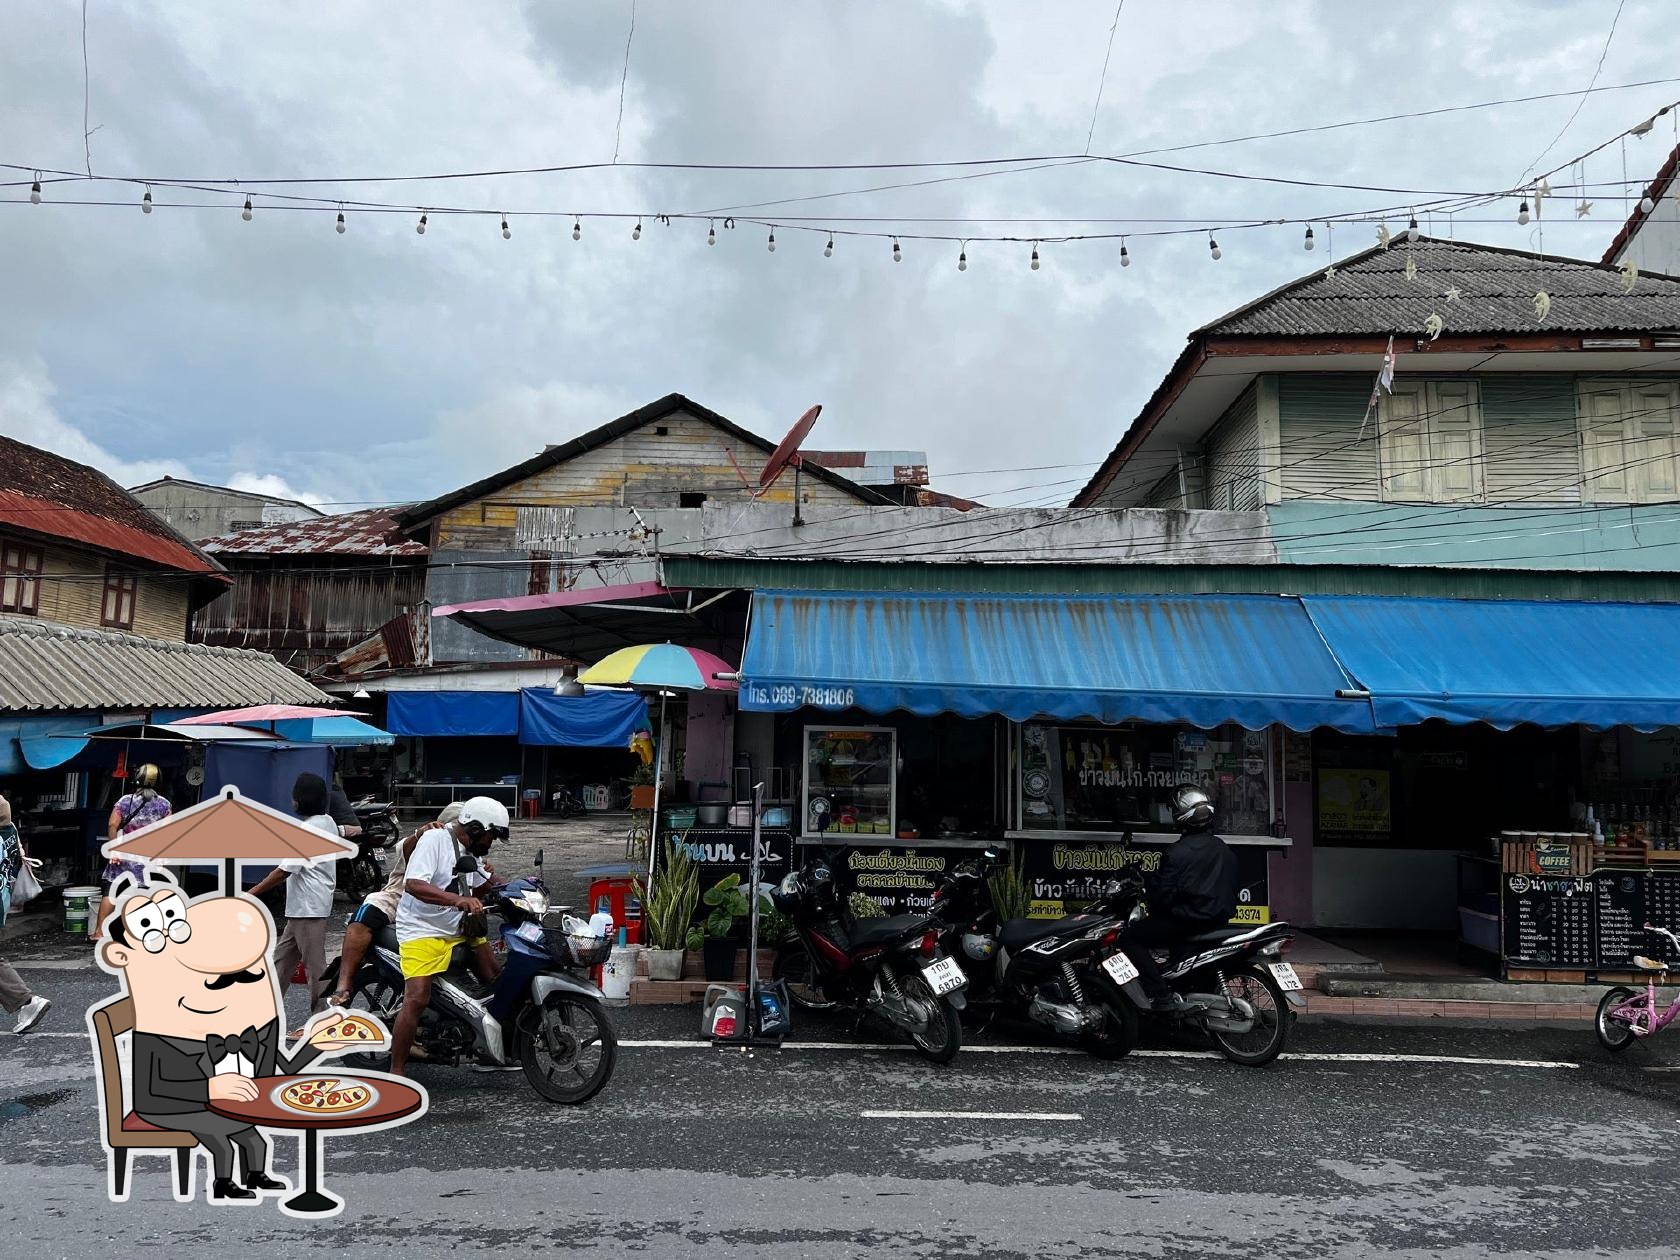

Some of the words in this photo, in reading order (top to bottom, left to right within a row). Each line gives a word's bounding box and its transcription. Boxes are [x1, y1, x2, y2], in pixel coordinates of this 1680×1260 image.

[771, 686, 854, 705] 089-7381806
[847, 848, 946, 871] ก๋วยเตี๋ยวน้ำแดง
[1539, 856, 1570, 866] COFFEE
[938, 976, 962, 992] 6870
[1284, 980, 1299, 989] 172
